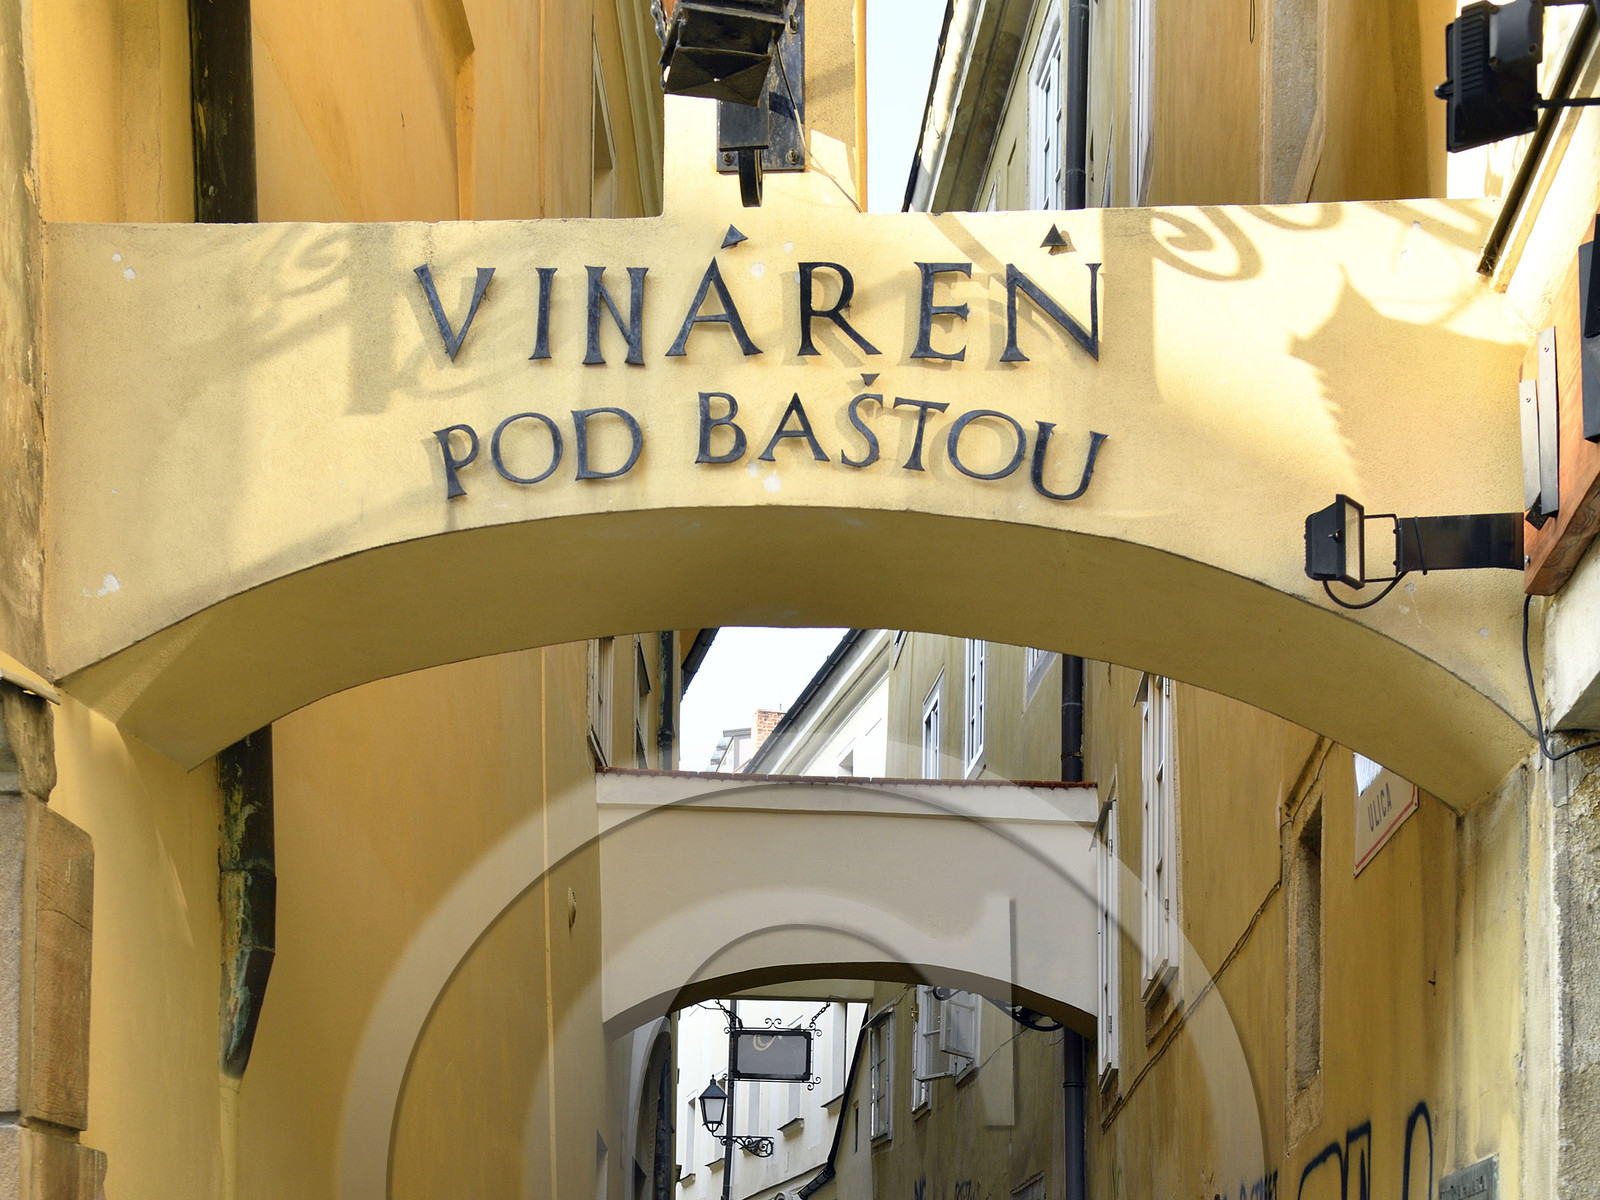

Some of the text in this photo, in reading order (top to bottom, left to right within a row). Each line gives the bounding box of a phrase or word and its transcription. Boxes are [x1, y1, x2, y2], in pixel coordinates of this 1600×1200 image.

[434, 373, 1109, 500] POD BAŠTOU
[1367, 782, 1393, 833] ULICA
